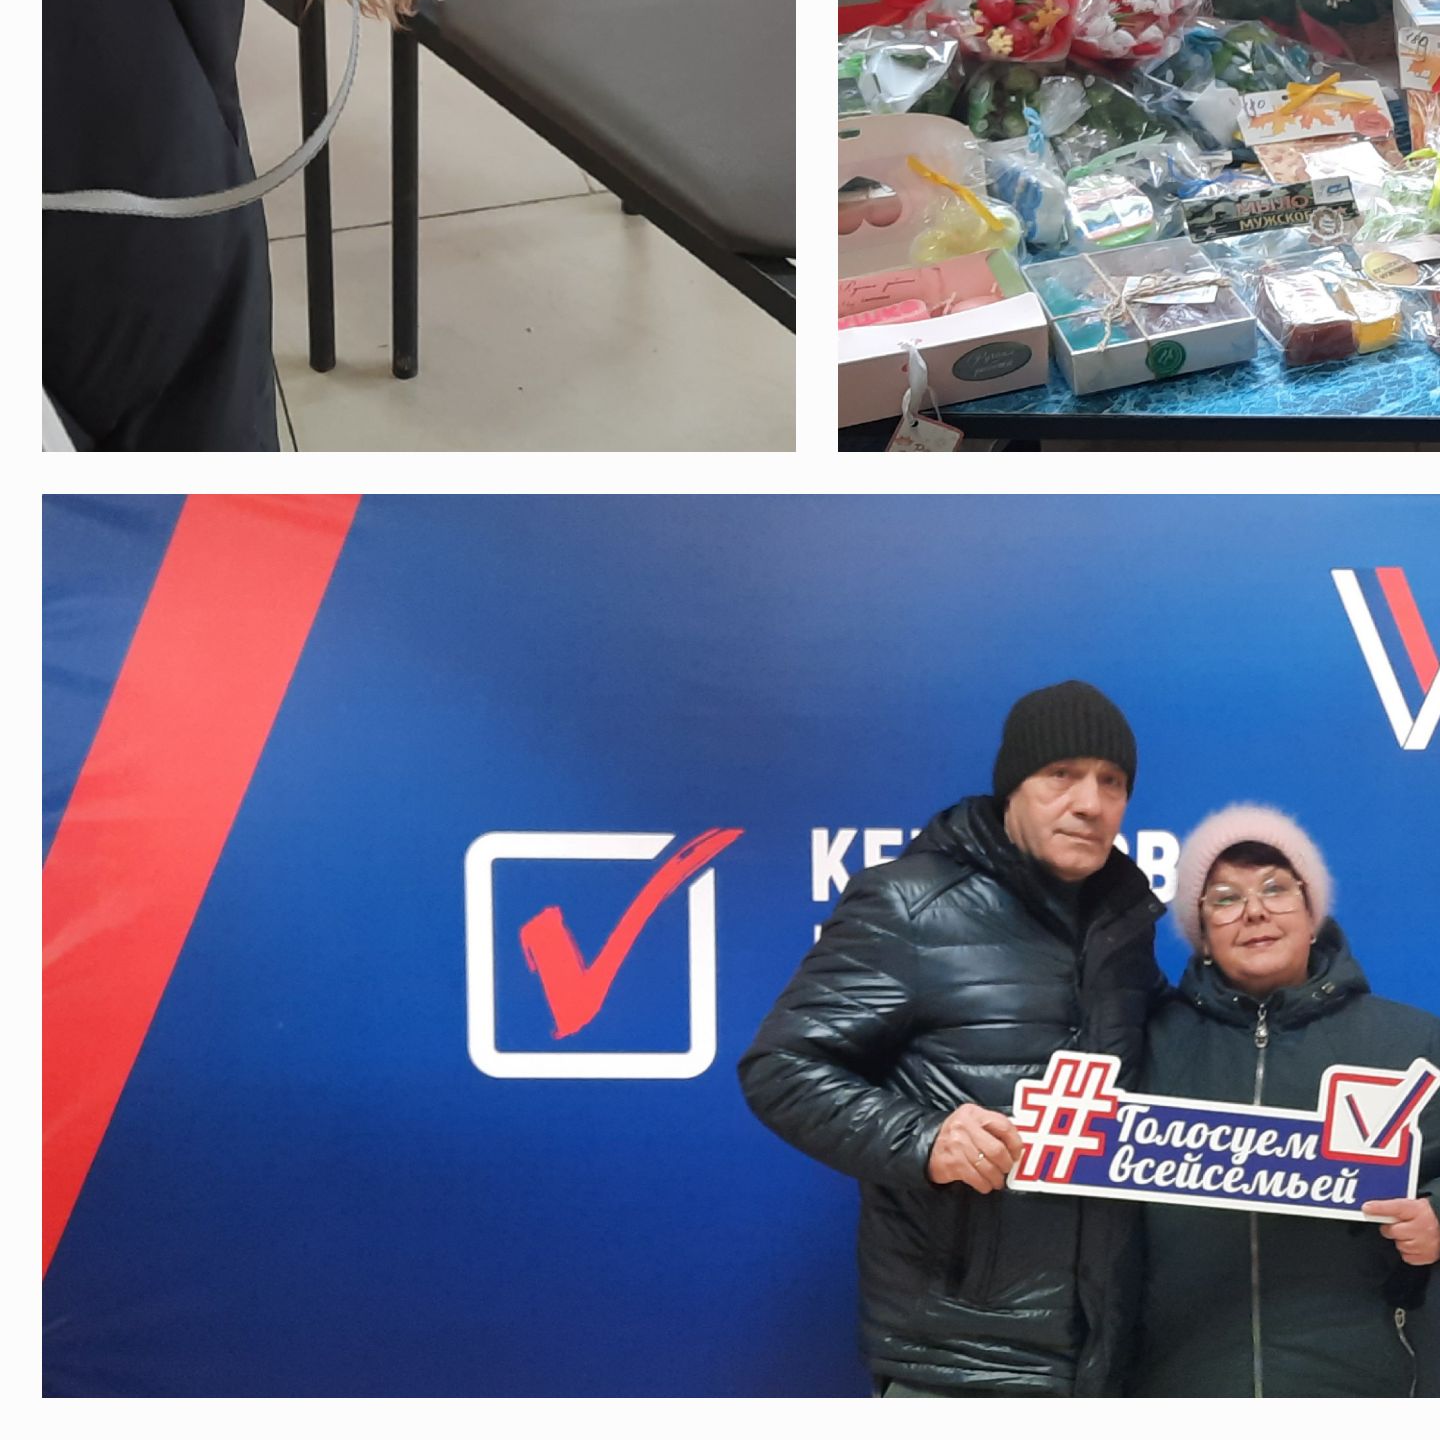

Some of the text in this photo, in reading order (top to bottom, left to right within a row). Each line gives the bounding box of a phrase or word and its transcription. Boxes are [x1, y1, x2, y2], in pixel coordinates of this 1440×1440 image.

[1235, 194, 1310, 219] МЫЛО
[1115, 1104, 1321, 1161] Голосуем
[1108, 1144, 1361, 1205] всейсемьей
